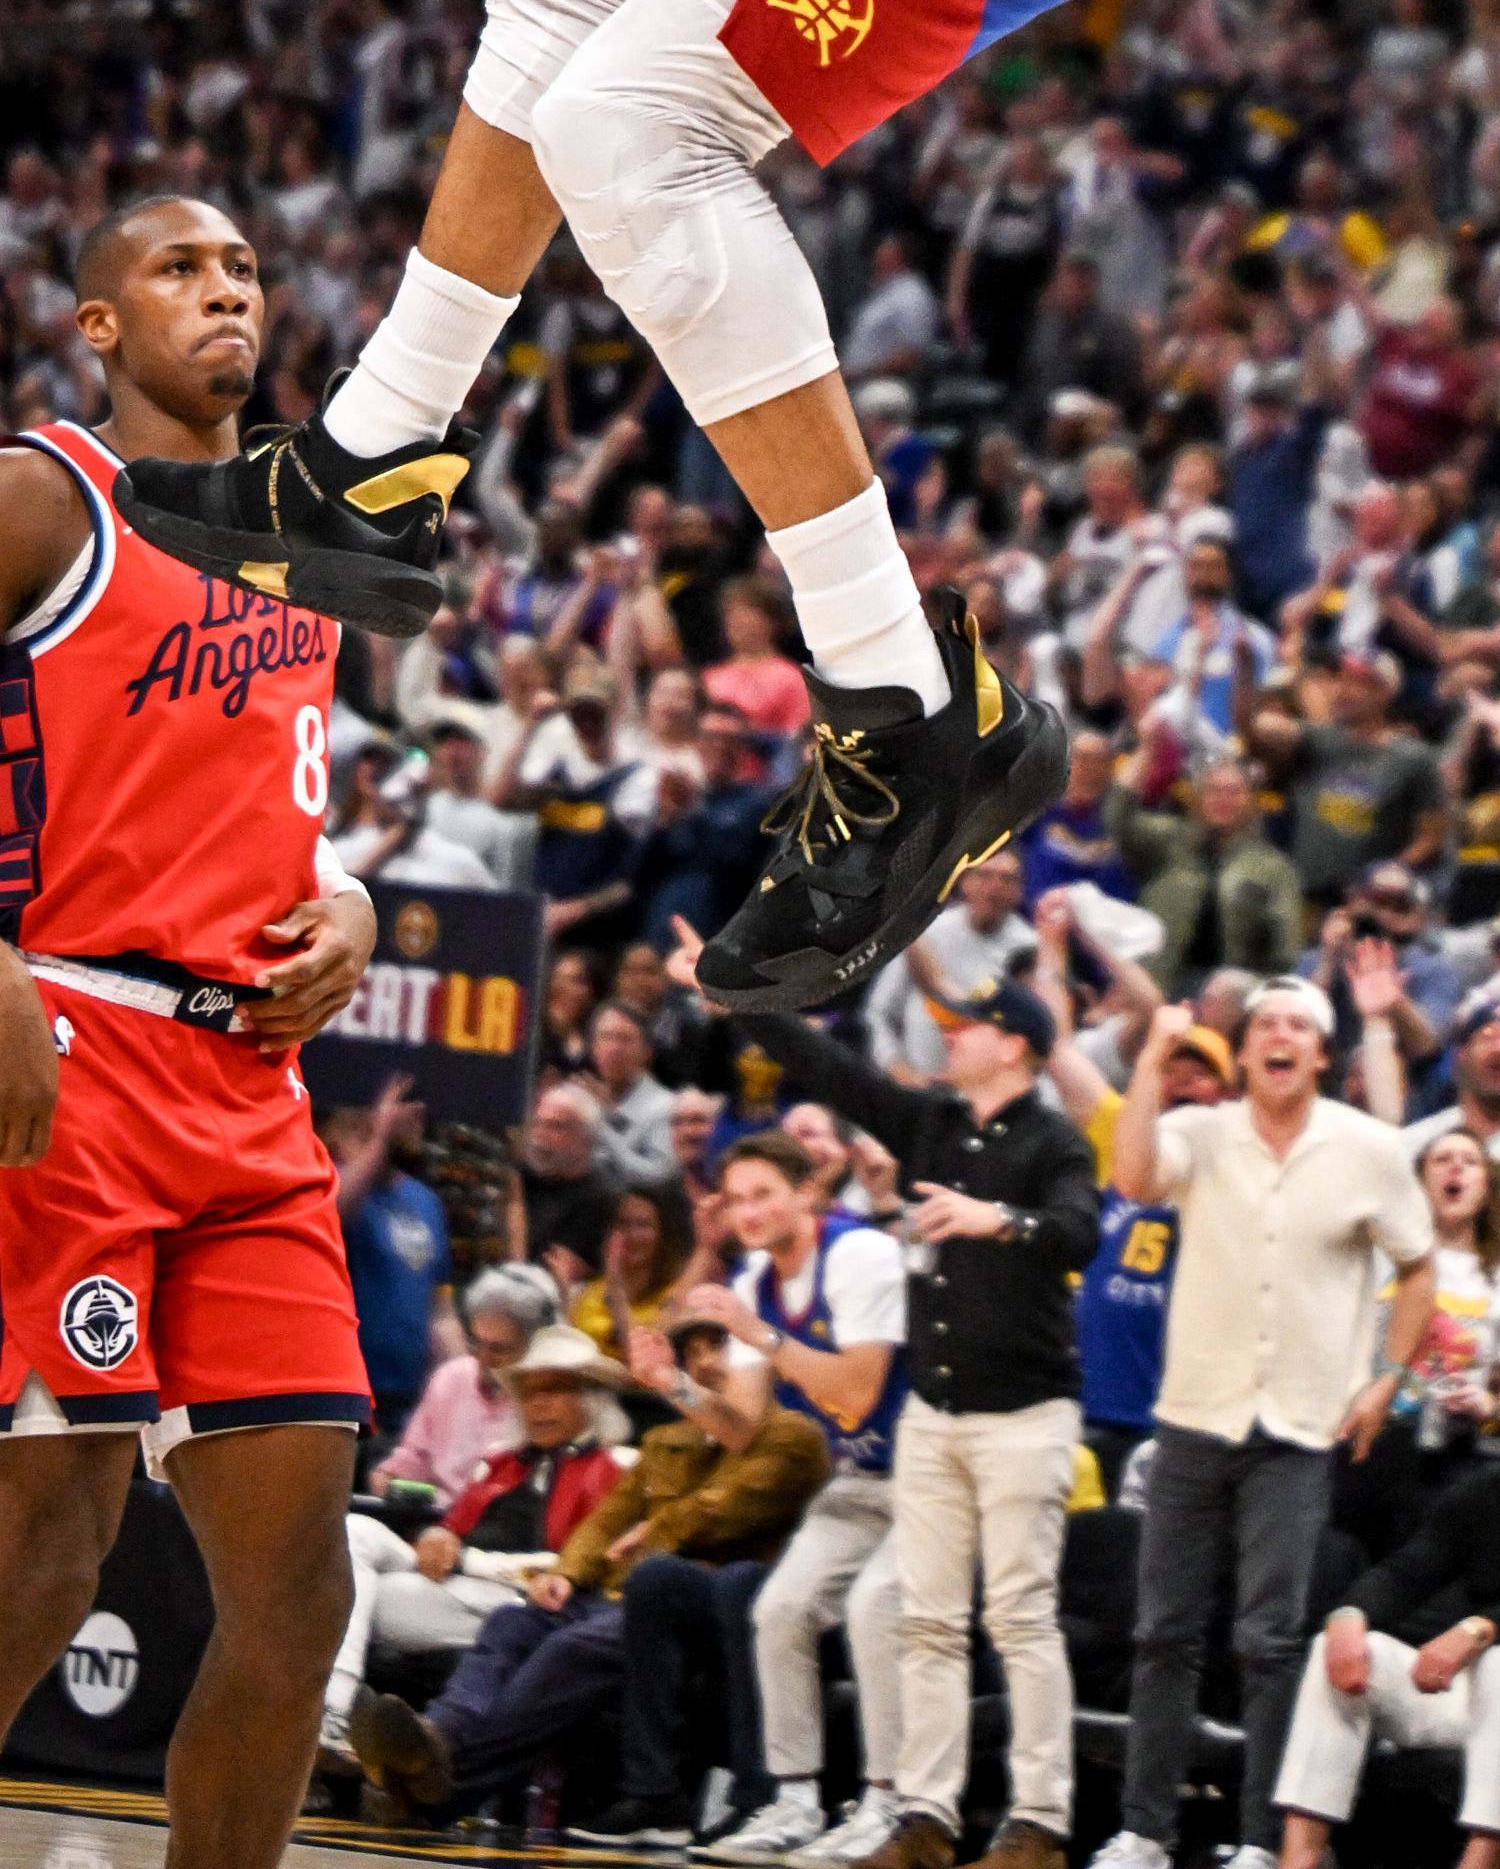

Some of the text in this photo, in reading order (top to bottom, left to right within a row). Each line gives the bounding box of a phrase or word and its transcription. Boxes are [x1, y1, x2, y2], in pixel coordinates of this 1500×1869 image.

[126, 602, 327, 718] Angeles
[293, 704, 328, 816] 8
[189, 987, 234, 1017] Clips
[320, 964, 519, 1054] EAT LA
[1121, 1220, 1170, 1273] 15
[67, 1645, 140, 1689] TNT
